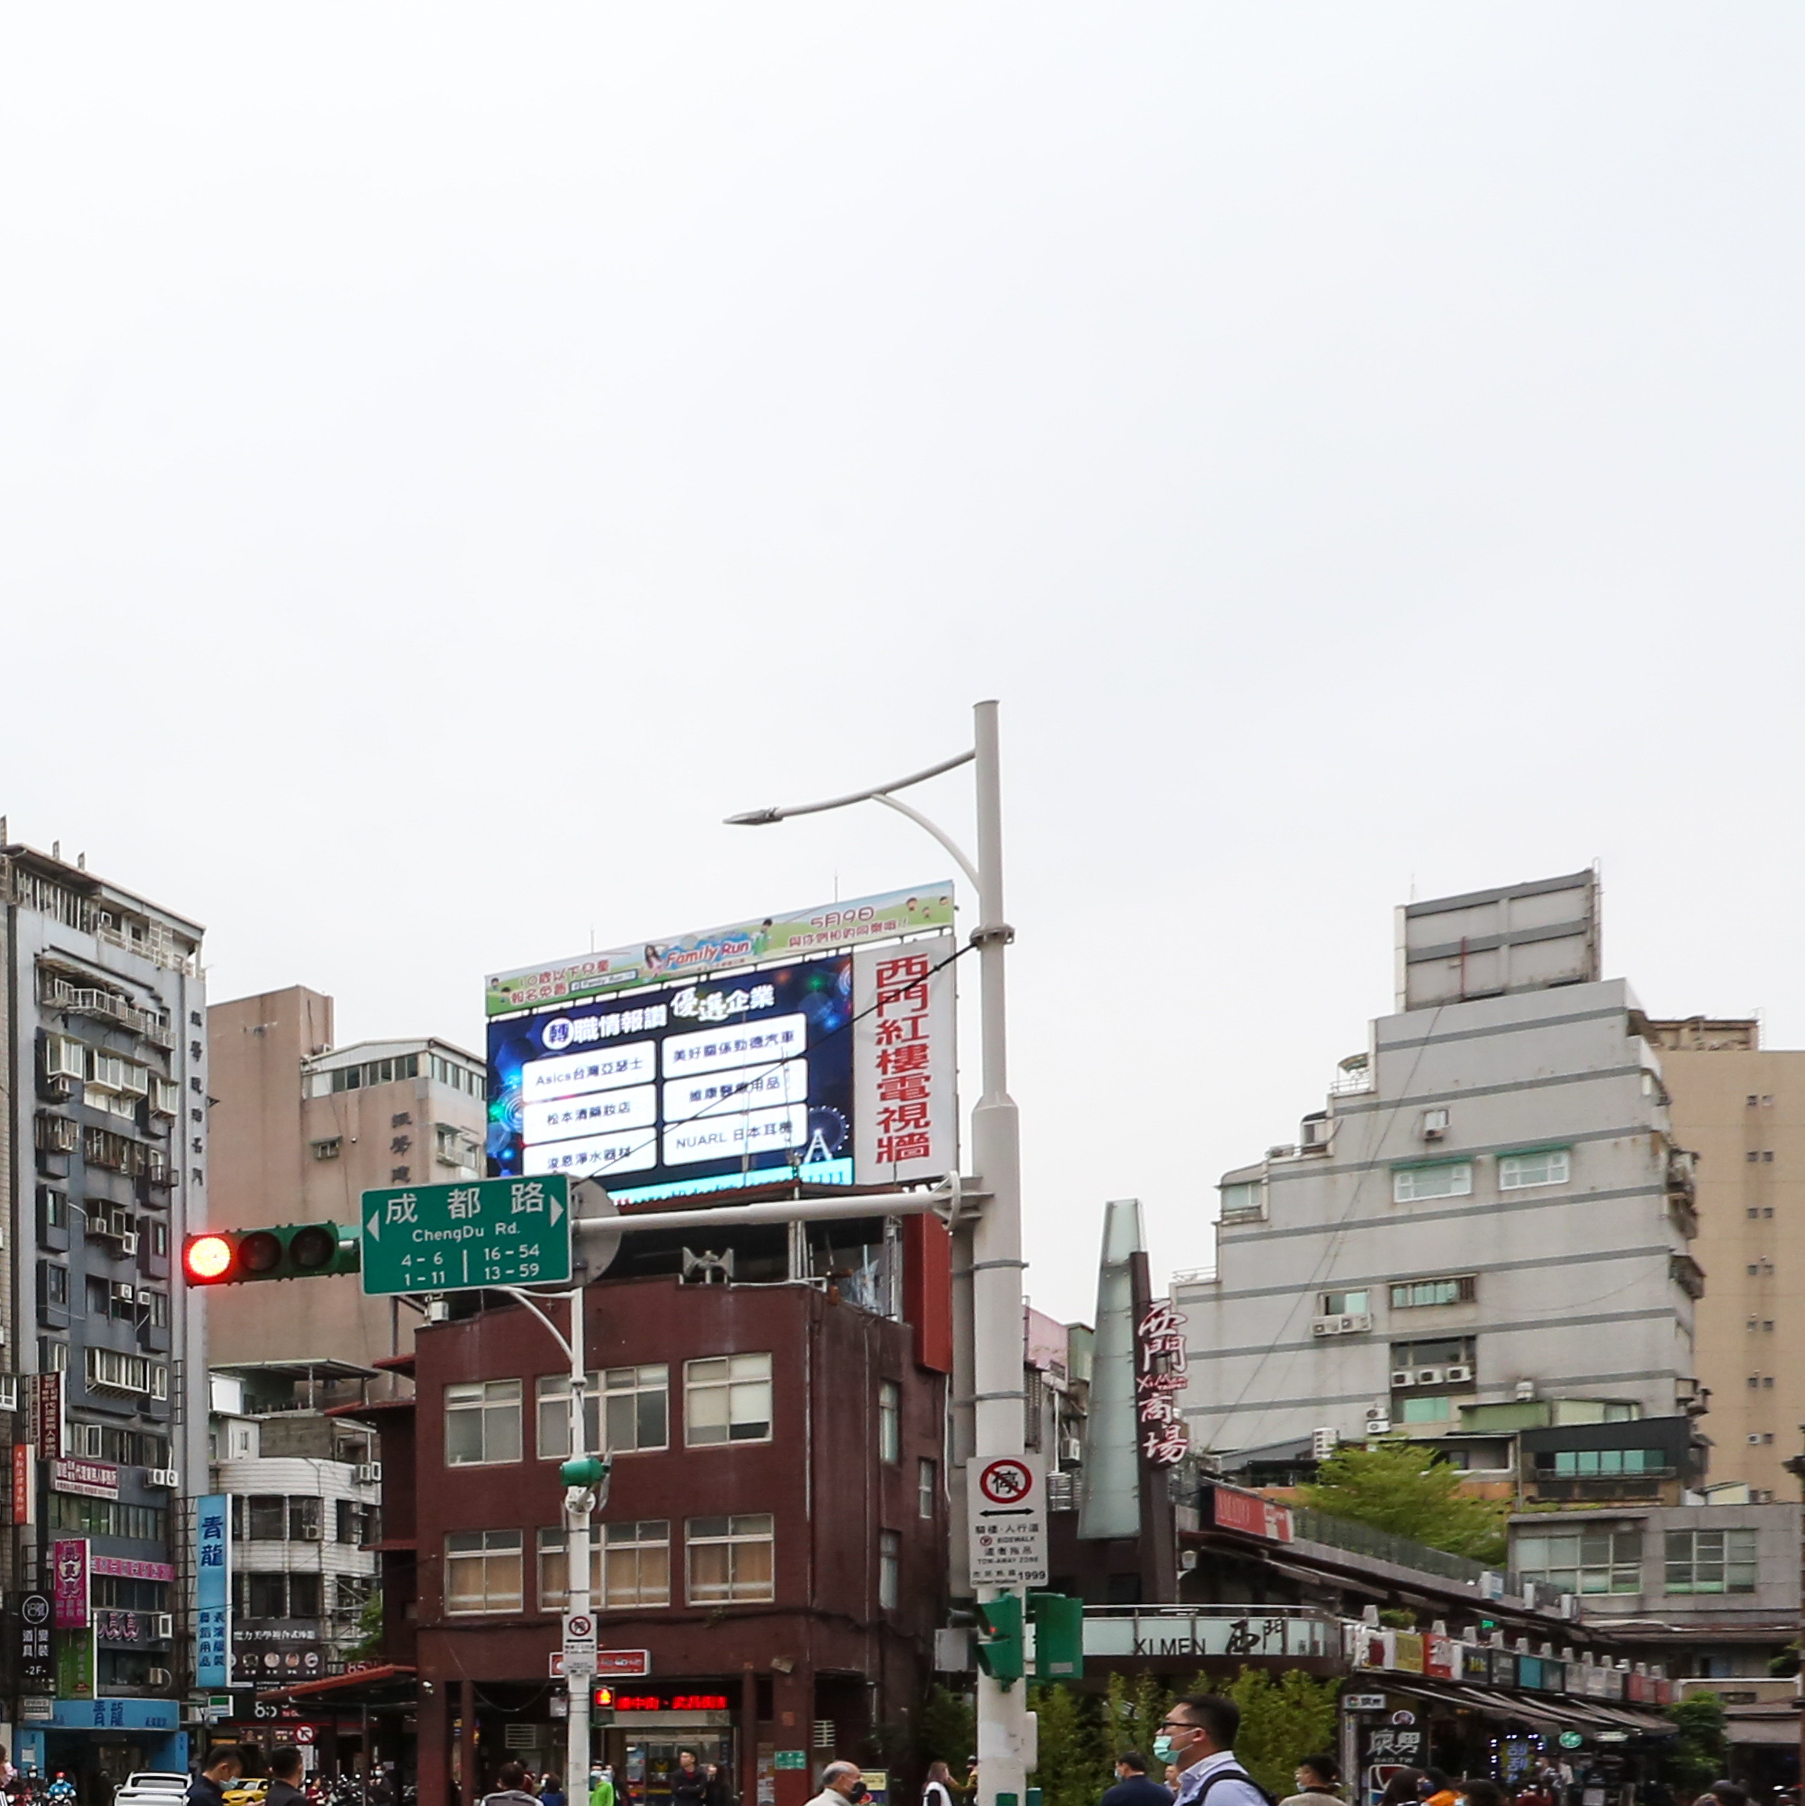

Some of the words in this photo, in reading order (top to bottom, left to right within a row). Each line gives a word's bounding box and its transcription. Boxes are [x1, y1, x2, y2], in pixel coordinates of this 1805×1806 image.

[810, 906, 875, 928] 5月9日
[664, 944, 718, 968] Family
[721, 939, 750, 955] Run
[670, 983, 775, 1022] 優選企業
[535, 1057, 644, 1087] Asics台灣亞瑟士
[875, 952, 930, 1165] 西門紅樓電視牆
[547, 1101, 631, 1126] 松本清藥妝店
[676, 1132, 728, 1150] NUARL
[732, 1121, 794, 1142] 日本耳機
[385, 1181, 546, 1226] 成都路
[412, 1226, 485, 1243] ChengDu
[494, 1223, 521, 1236] Rd.
[1138, 1297, 1188, 1374] 西門
[1138, 1391, 1190, 1465] 商場
[991, 1469, 1019, 1495] 停
[200, 1515, 224, 1568] 青龍
[1017, 1570, 1047, 1581] 1999
[22, 1629, 33, 1658] 道具
[1225, 1617, 1287, 1656] 西門
[92, 1700, 124, 1727] 青龍
